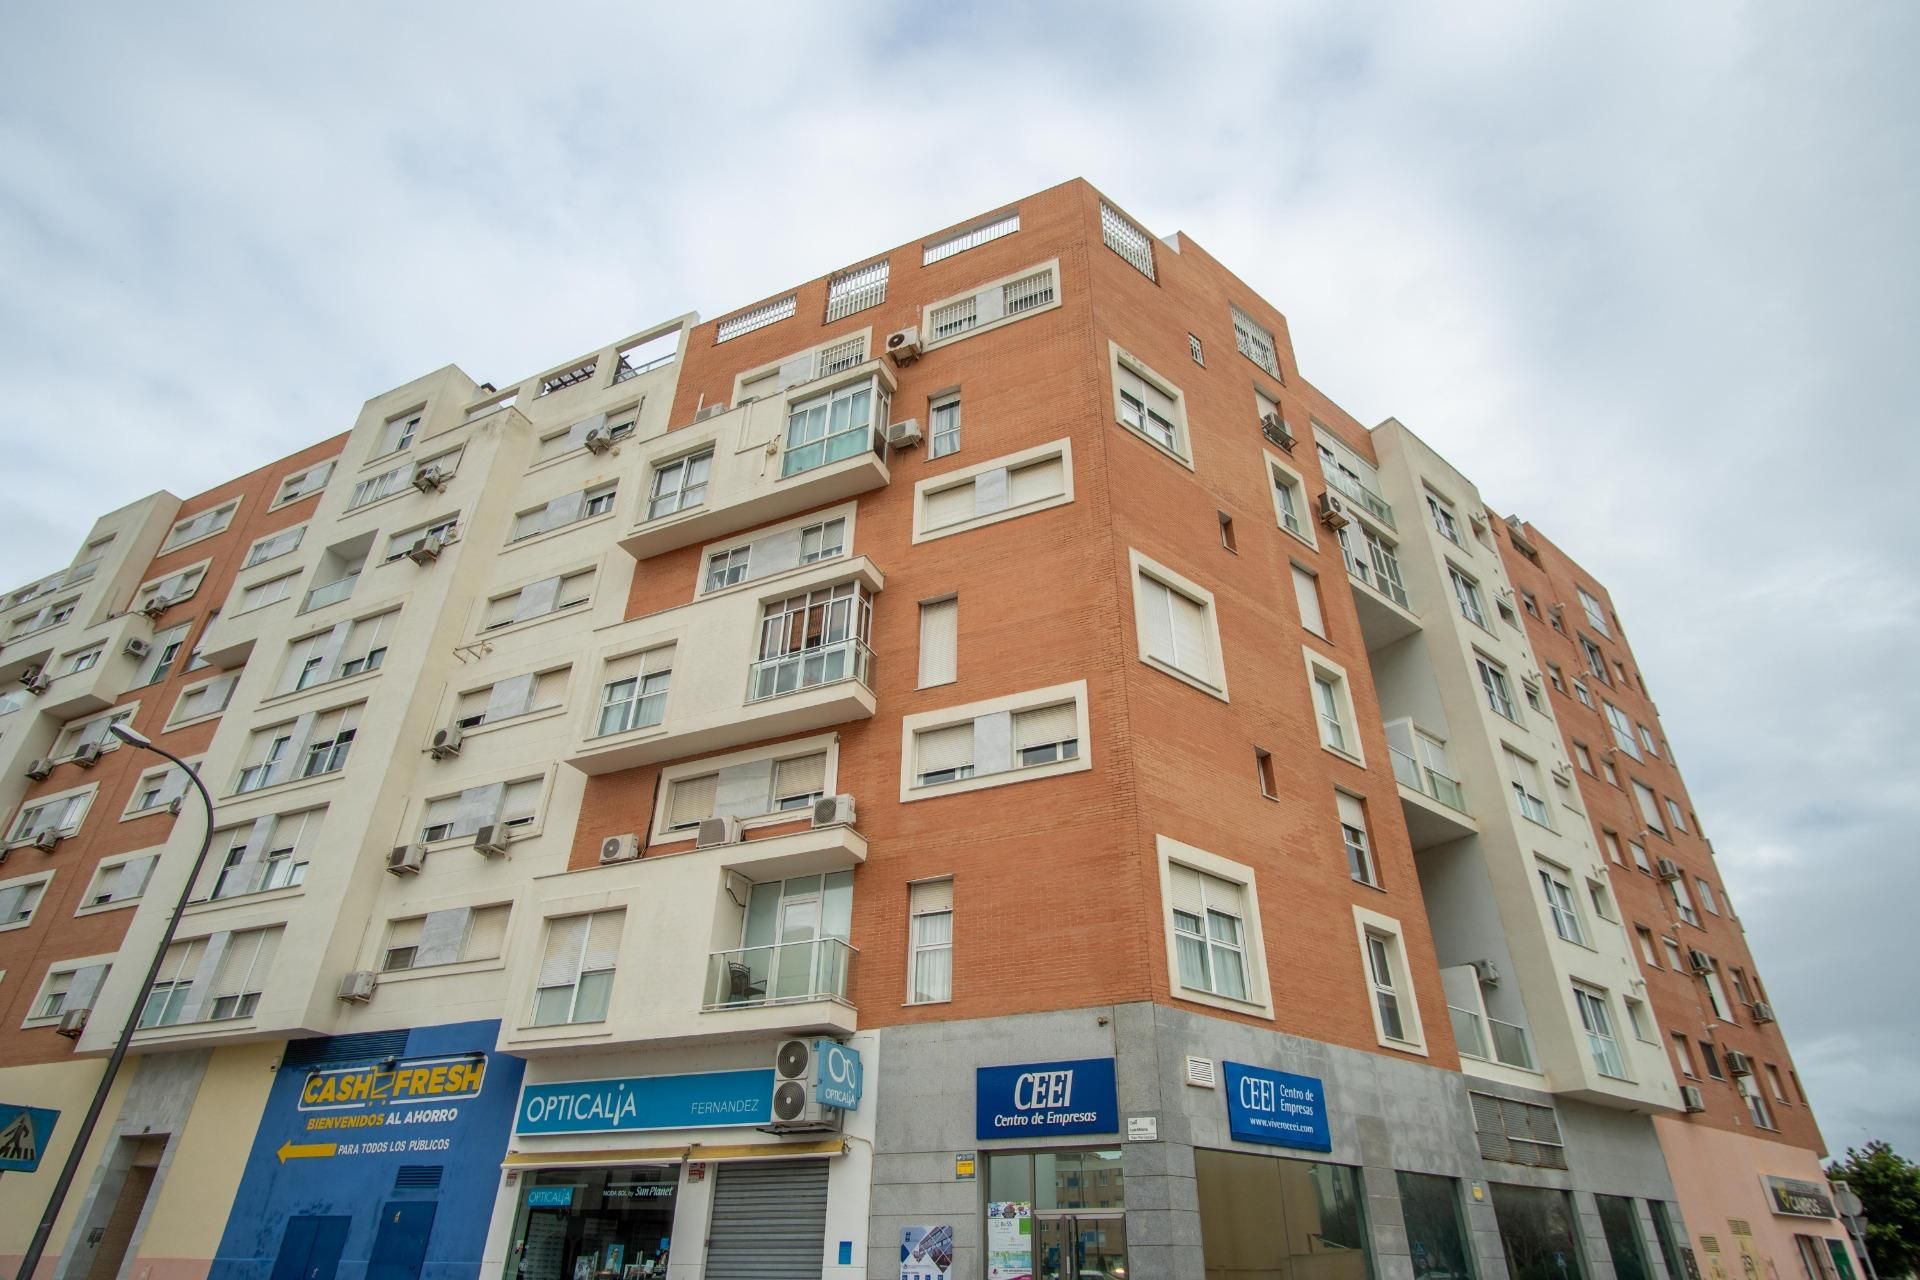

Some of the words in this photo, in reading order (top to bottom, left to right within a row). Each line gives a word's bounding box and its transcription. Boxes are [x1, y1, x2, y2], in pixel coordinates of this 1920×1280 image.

[304, 1073, 372, 1104] CASH
[392, 1062, 485, 1098] FRESH
[1014, 1069, 1074, 1110] CEEI
[1240, 1075, 1275, 1112] CEEI
[1279, 1084, 1303, 1100] Centro
[1305, 1088, 1314, 1102] de
[691, 1099, 760, 1115] FERNANDEZ
[1280, 1098, 1314, 1117] Empresas
[306, 1112, 385, 1131] BIENVENIDOS
[385, 1111, 402, 1126] AL
[403, 1107, 458, 1125] AHORRO
[994, 1113, 1029, 1127] Centro
[1031, 1112, 1043, 1125] de
[1046, 1111, 1097, 1126] Empresas
[1250, 1117, 1314, 1133] www.viveroceei.com
[338, 1143, 359, 1155] PARA
[361, 1142, 388, 1153] TODOS
[389, 1140, 407, 1152] LOS
[409, 1137, 450, 1151] PÚBLICOS
[635, 1186, 649, 1196] Sun
[649, 1186, 673, 1196] Planet
